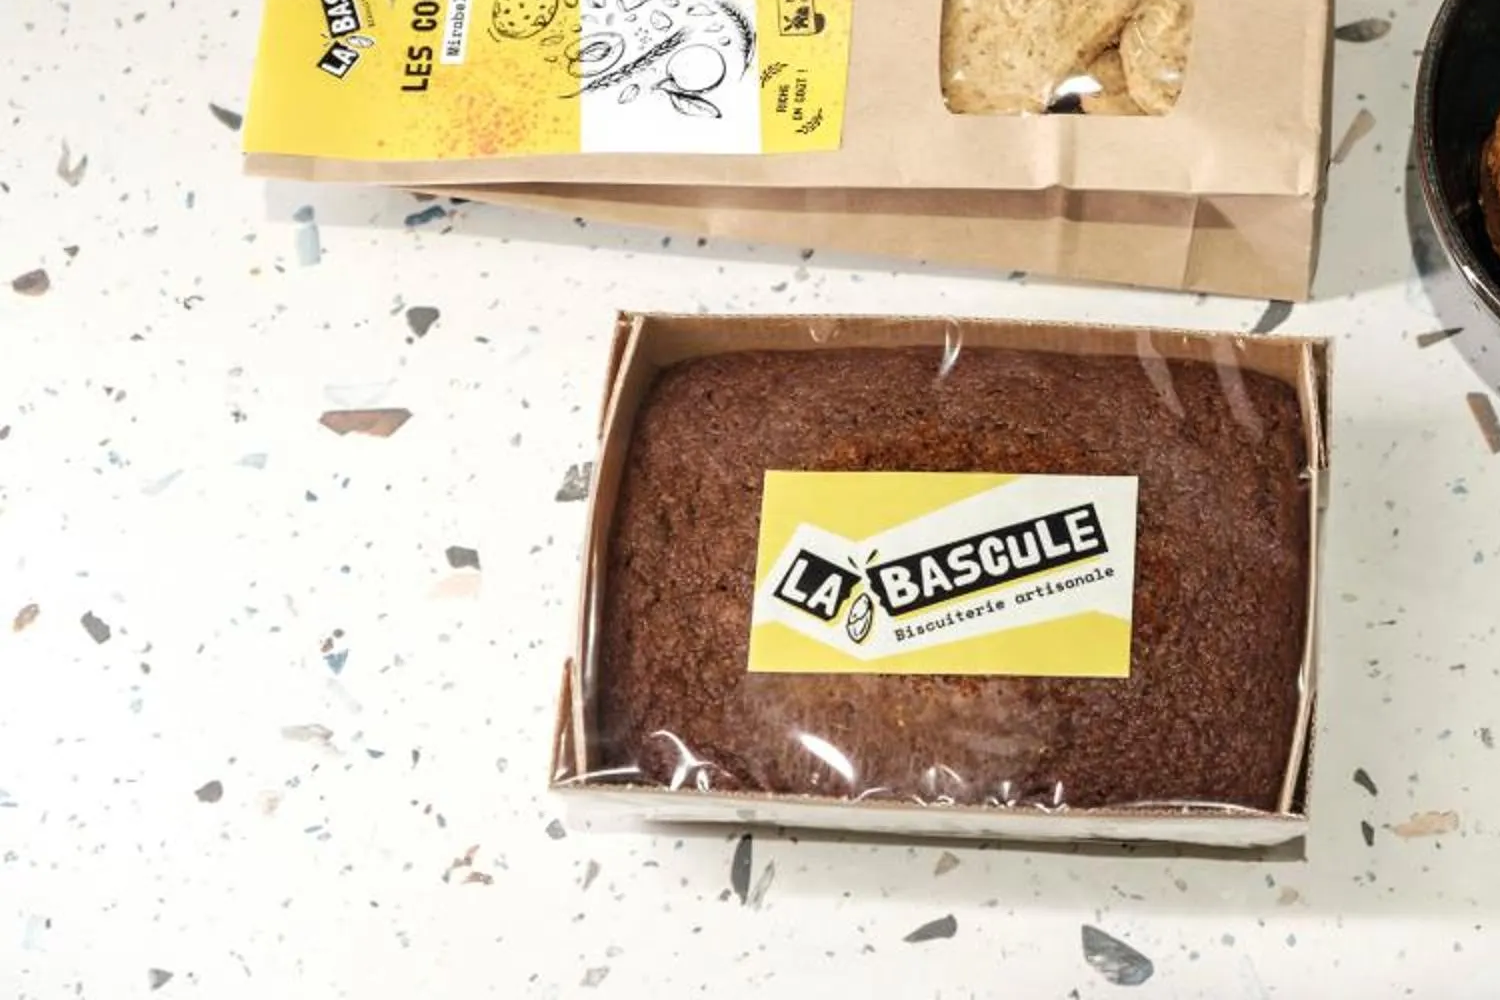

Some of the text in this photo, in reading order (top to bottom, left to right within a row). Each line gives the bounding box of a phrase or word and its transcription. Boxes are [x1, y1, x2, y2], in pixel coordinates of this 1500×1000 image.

[320, 47, 358, 78] LA
[401, 45, 433, 92] LES
[776, 83, 790, 113] RICHE
[779, 508, 1099, 616] LA BASCULE
[894, 565, 1115, 642] Biscuiterie artisanale
